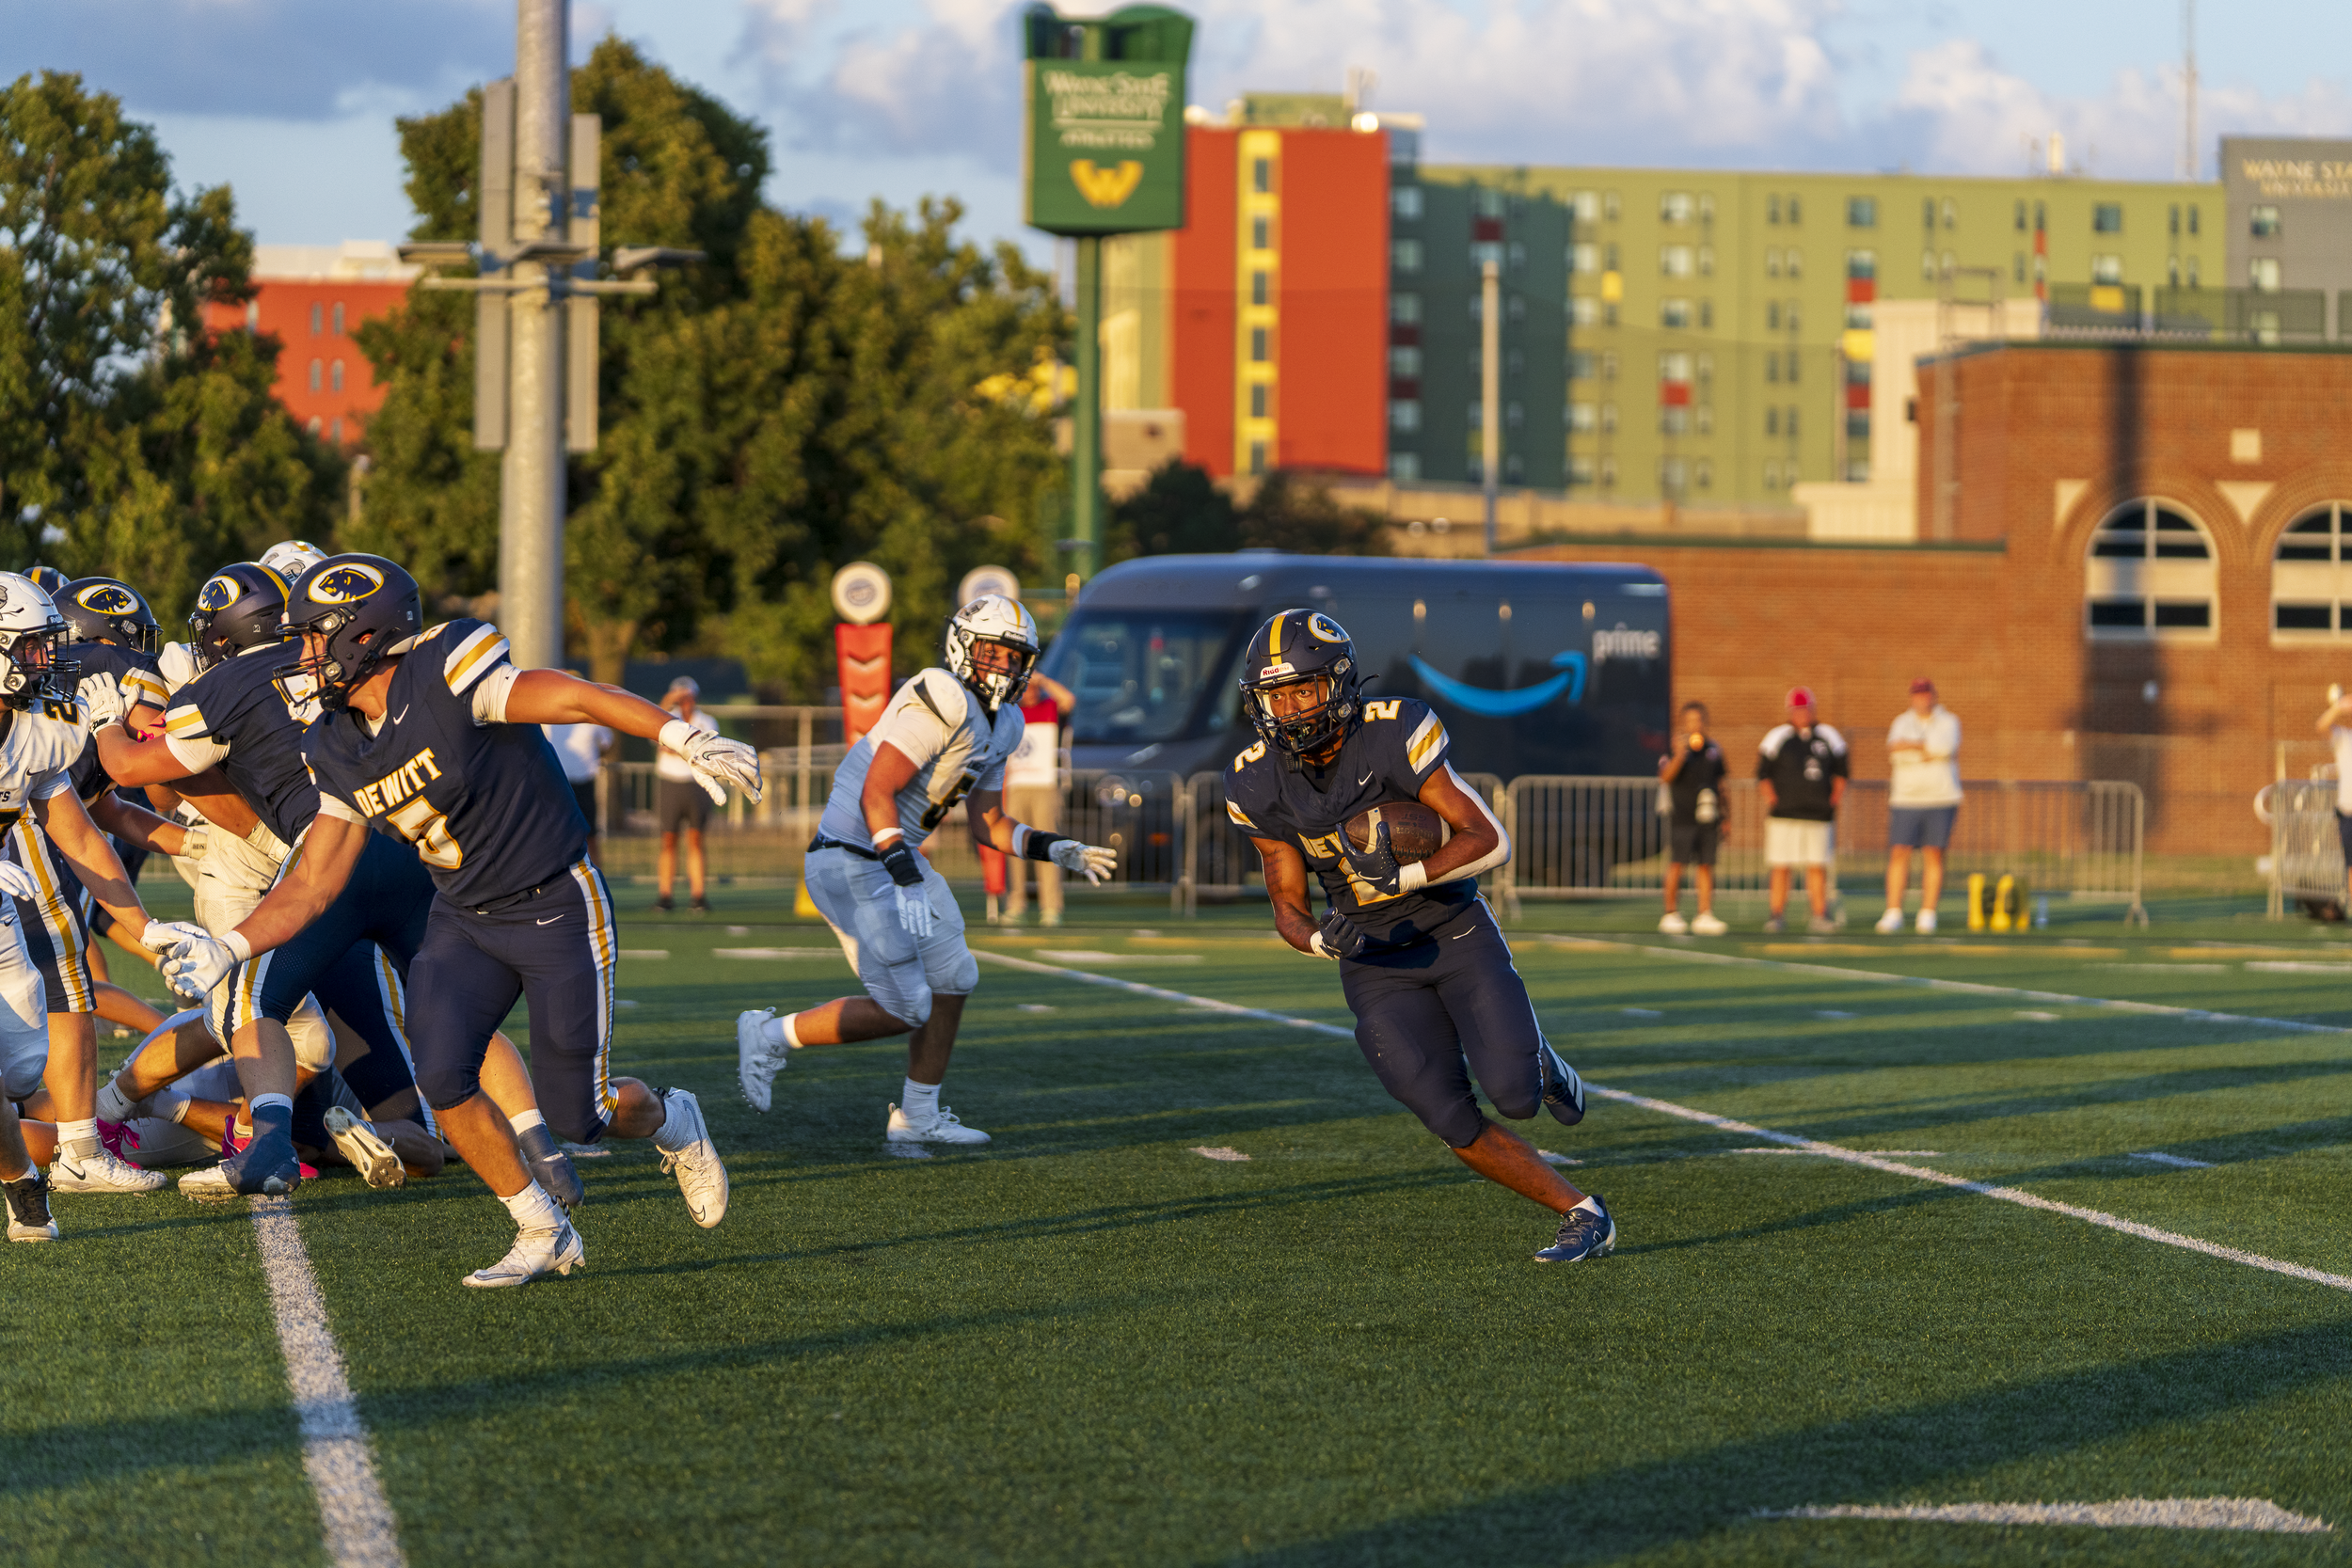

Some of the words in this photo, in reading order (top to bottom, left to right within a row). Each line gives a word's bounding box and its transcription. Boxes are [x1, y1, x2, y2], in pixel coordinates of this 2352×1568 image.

[2243, 159, 2314, 181] WAYNE
[1593, 622, 1660, 664] prime
[1364, 700, 1403, 723] 2
[1234, 739, 1266, 773] 2
[352, 747, 443, 818] DEWITT
